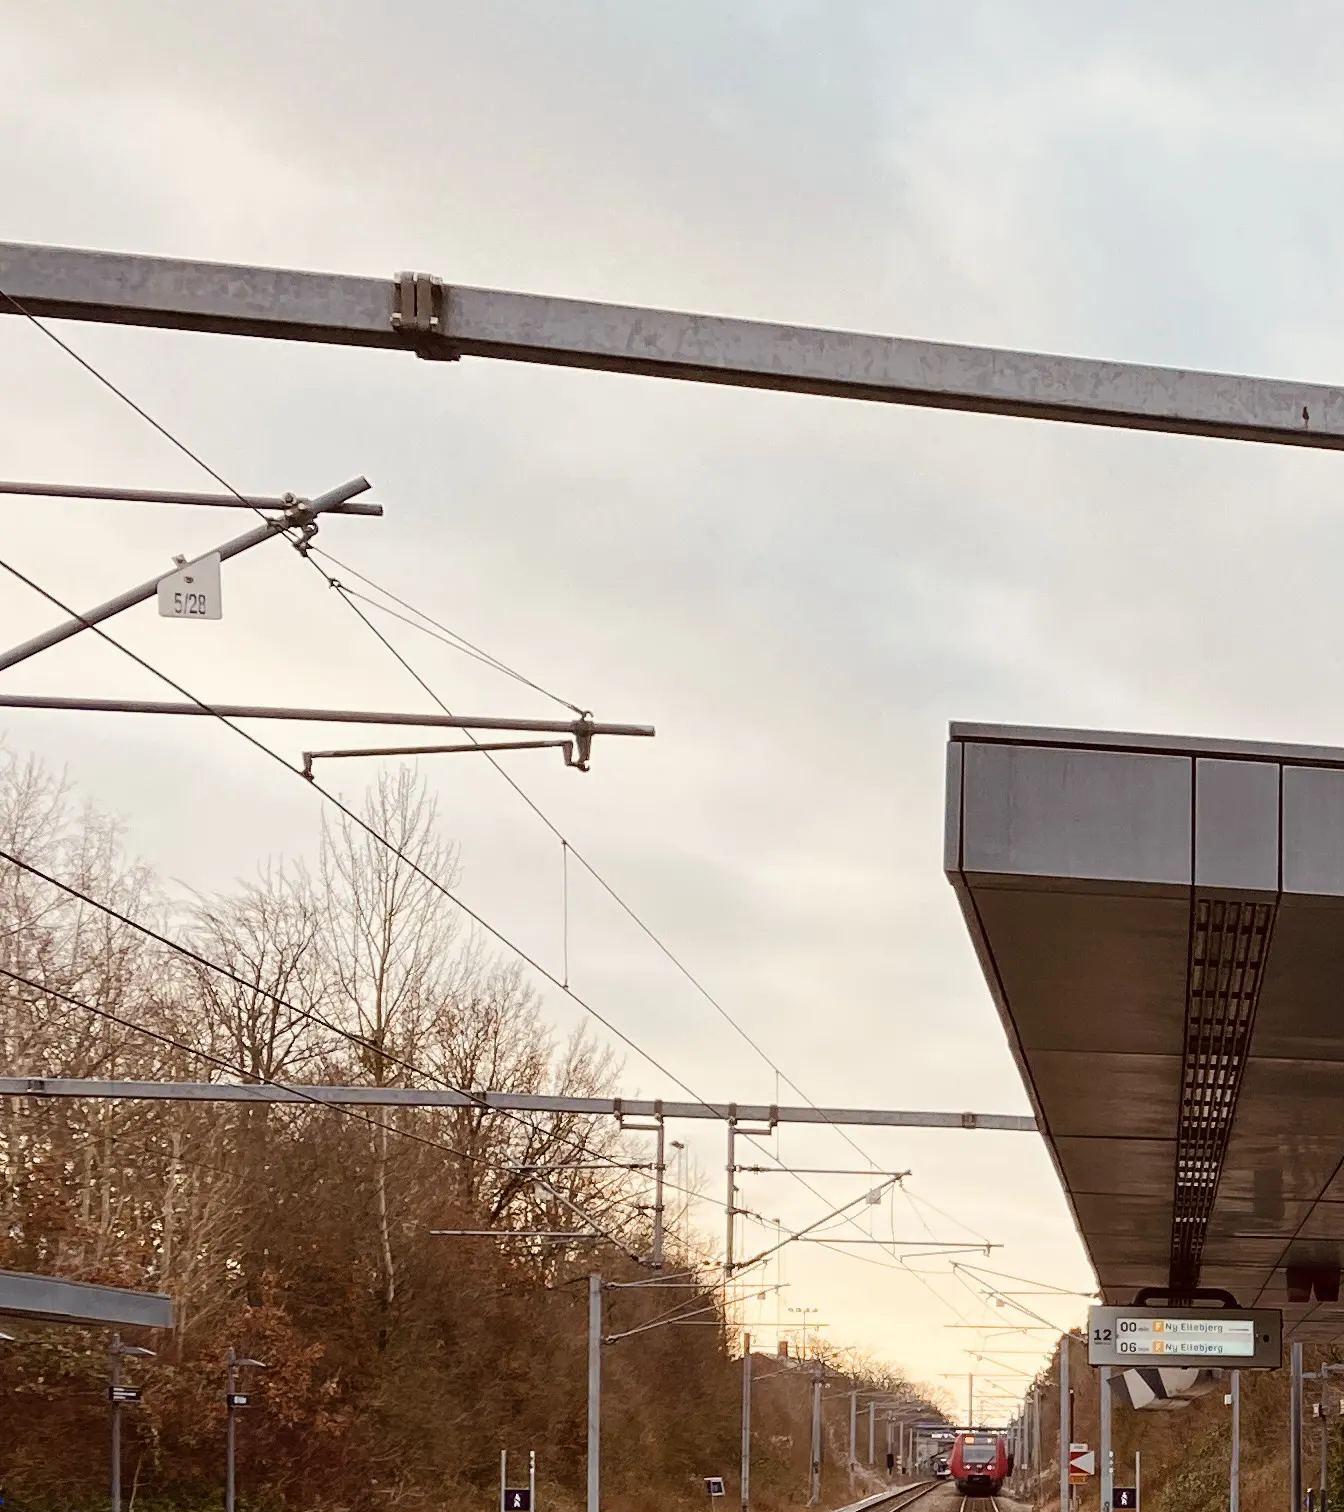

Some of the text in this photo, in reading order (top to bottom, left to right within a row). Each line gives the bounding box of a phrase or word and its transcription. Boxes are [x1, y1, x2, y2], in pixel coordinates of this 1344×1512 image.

[174, 592, 206, 614] 5/28
[1120, 1321, 1137, 1332] 00
[1165, 1323, 1178, 1333] Ny
[1093, 1329, 1112, 1341] 12
[1120, 1342, 1137, 1353] 06
[1165, 1344, 1178, 1353] Ny
